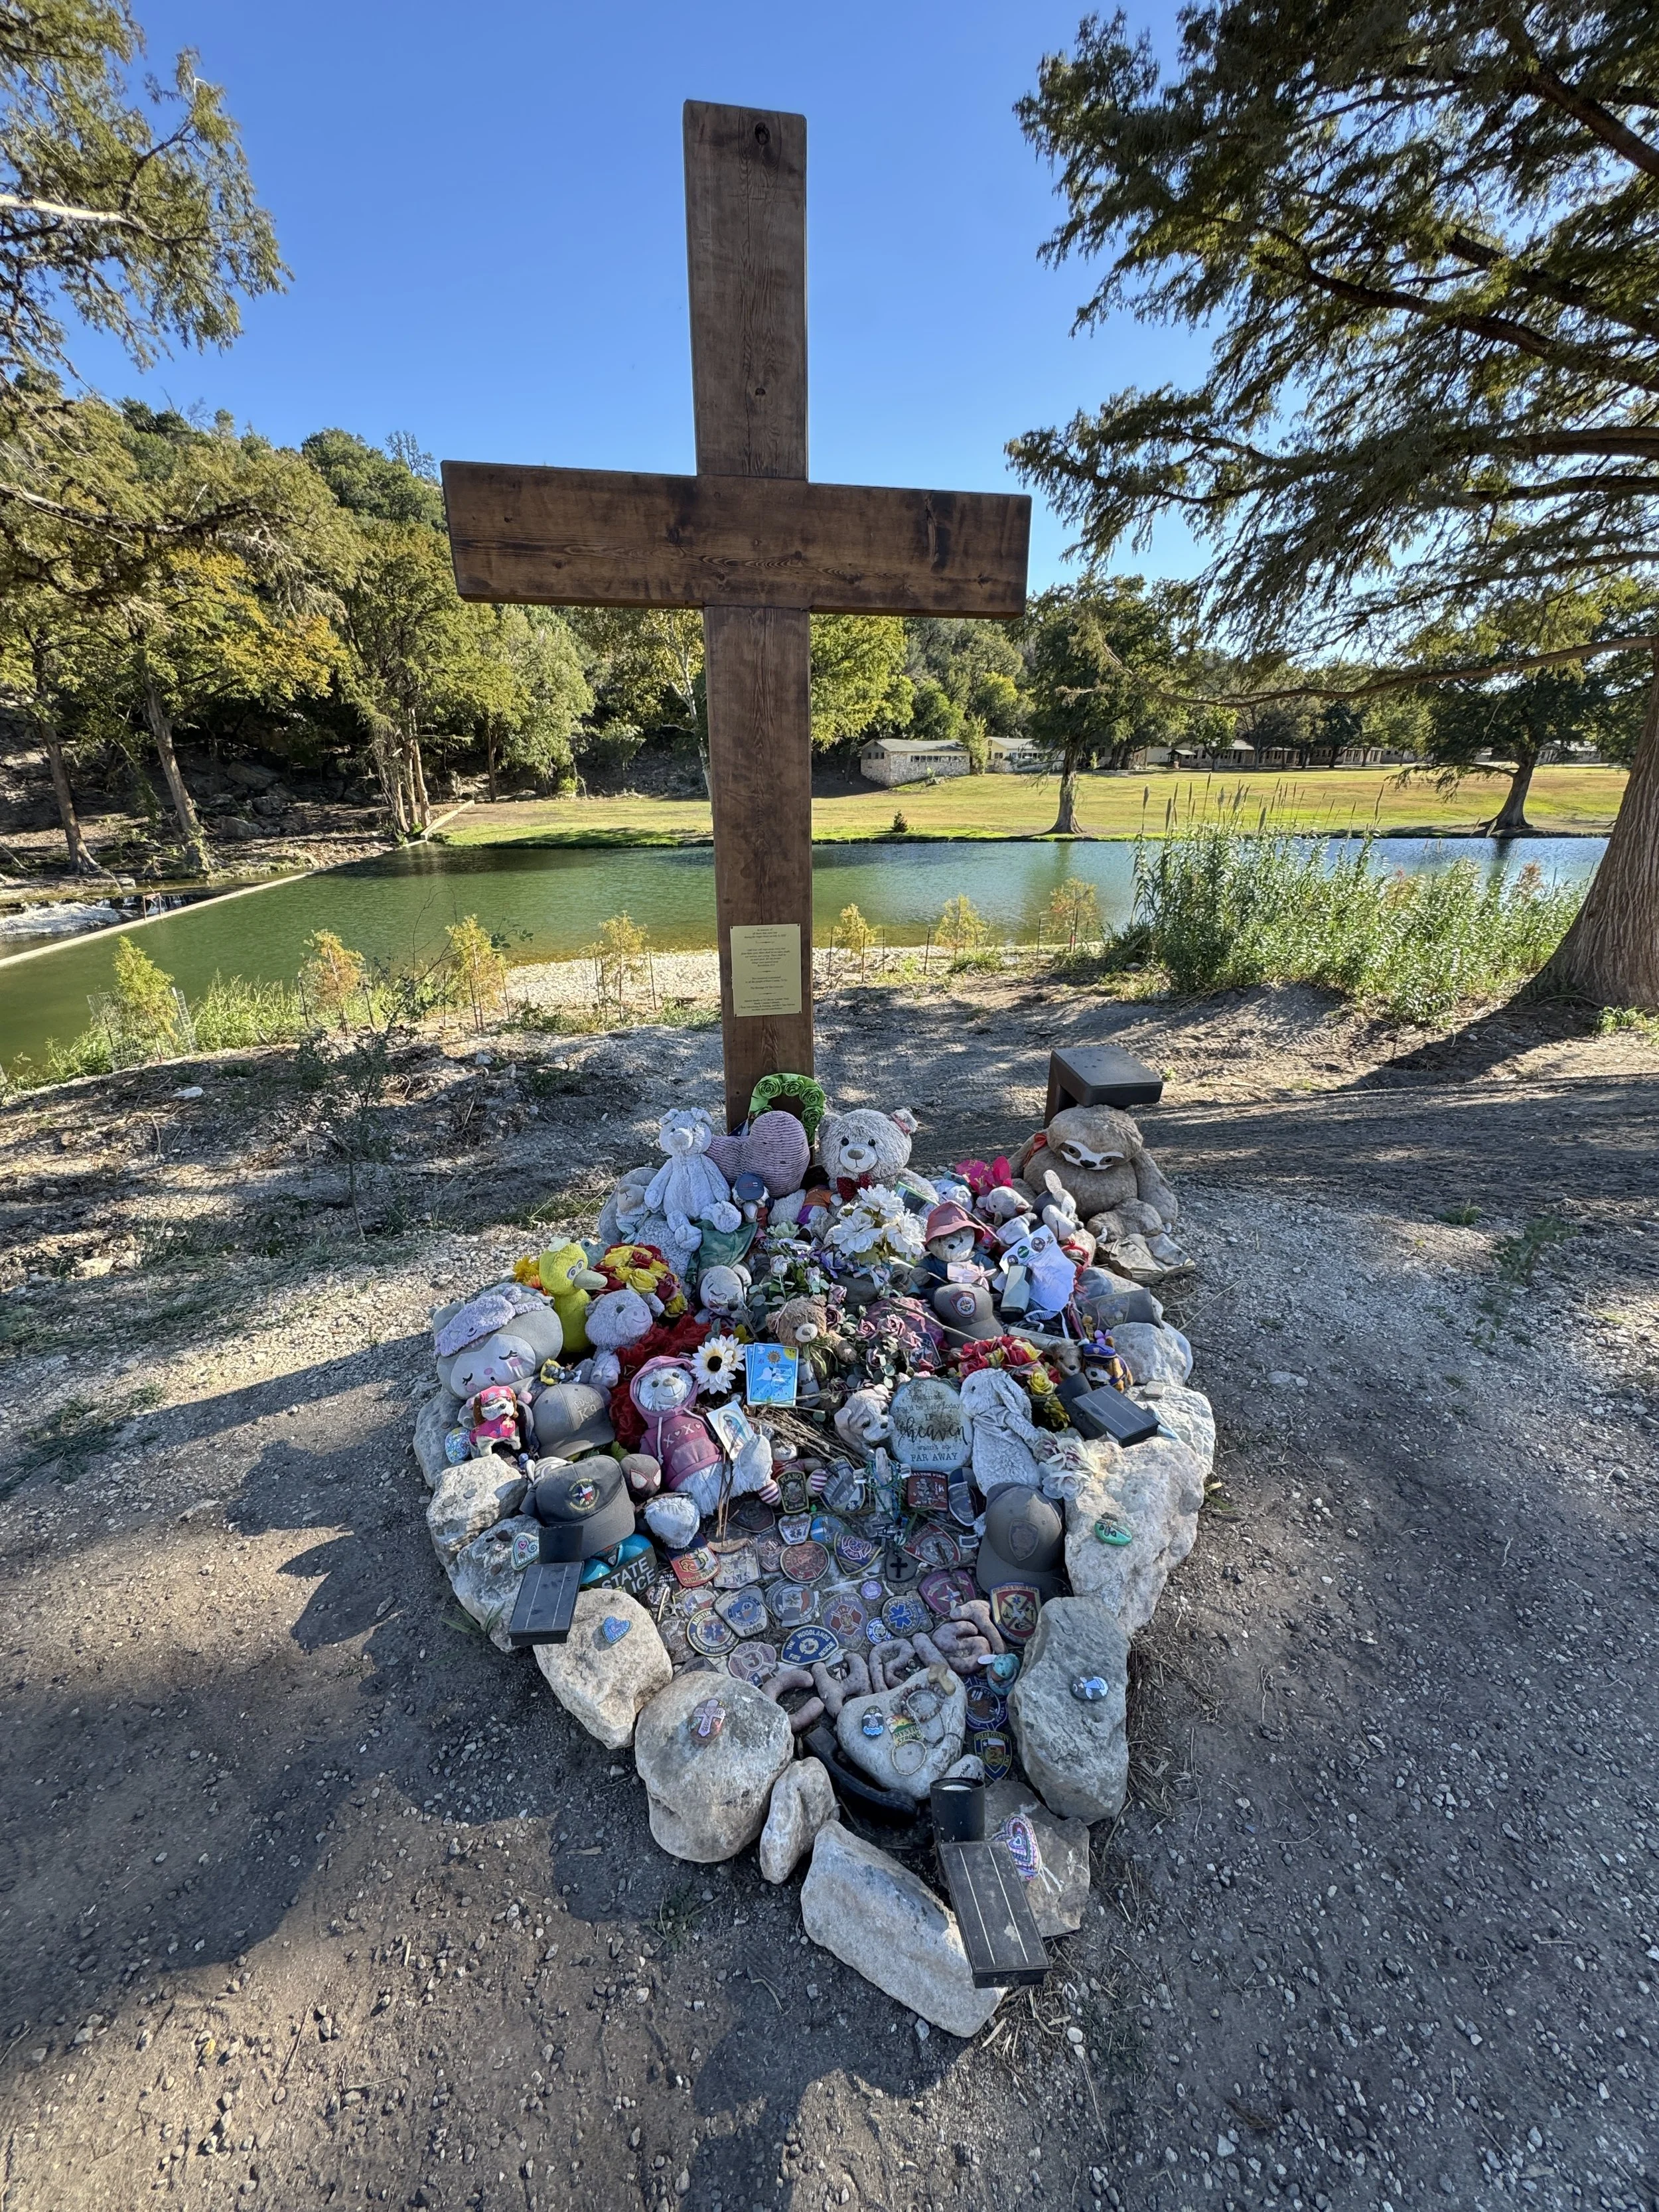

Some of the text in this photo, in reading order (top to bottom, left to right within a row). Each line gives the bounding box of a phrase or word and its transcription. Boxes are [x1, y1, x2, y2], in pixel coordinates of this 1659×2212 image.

[898, 1416, 968, 1447] heaven
[780, 1473, 802, 1484] PLANO
[601, 1556, 650, 1589] STATE
[692, 1610, 712, 1626] AUSTIN
[743, 1623, 763, 1635] EMS
[786, 1639, 796, 1651] THE
[796, 1629, 831, 1642] WOODLANDS
[788, 1641, 836, 1662] FIRE RESCUE
[894, 1726, 920, 1739] MYSTIC
[897, 1732, 922, 1743] STRONG
